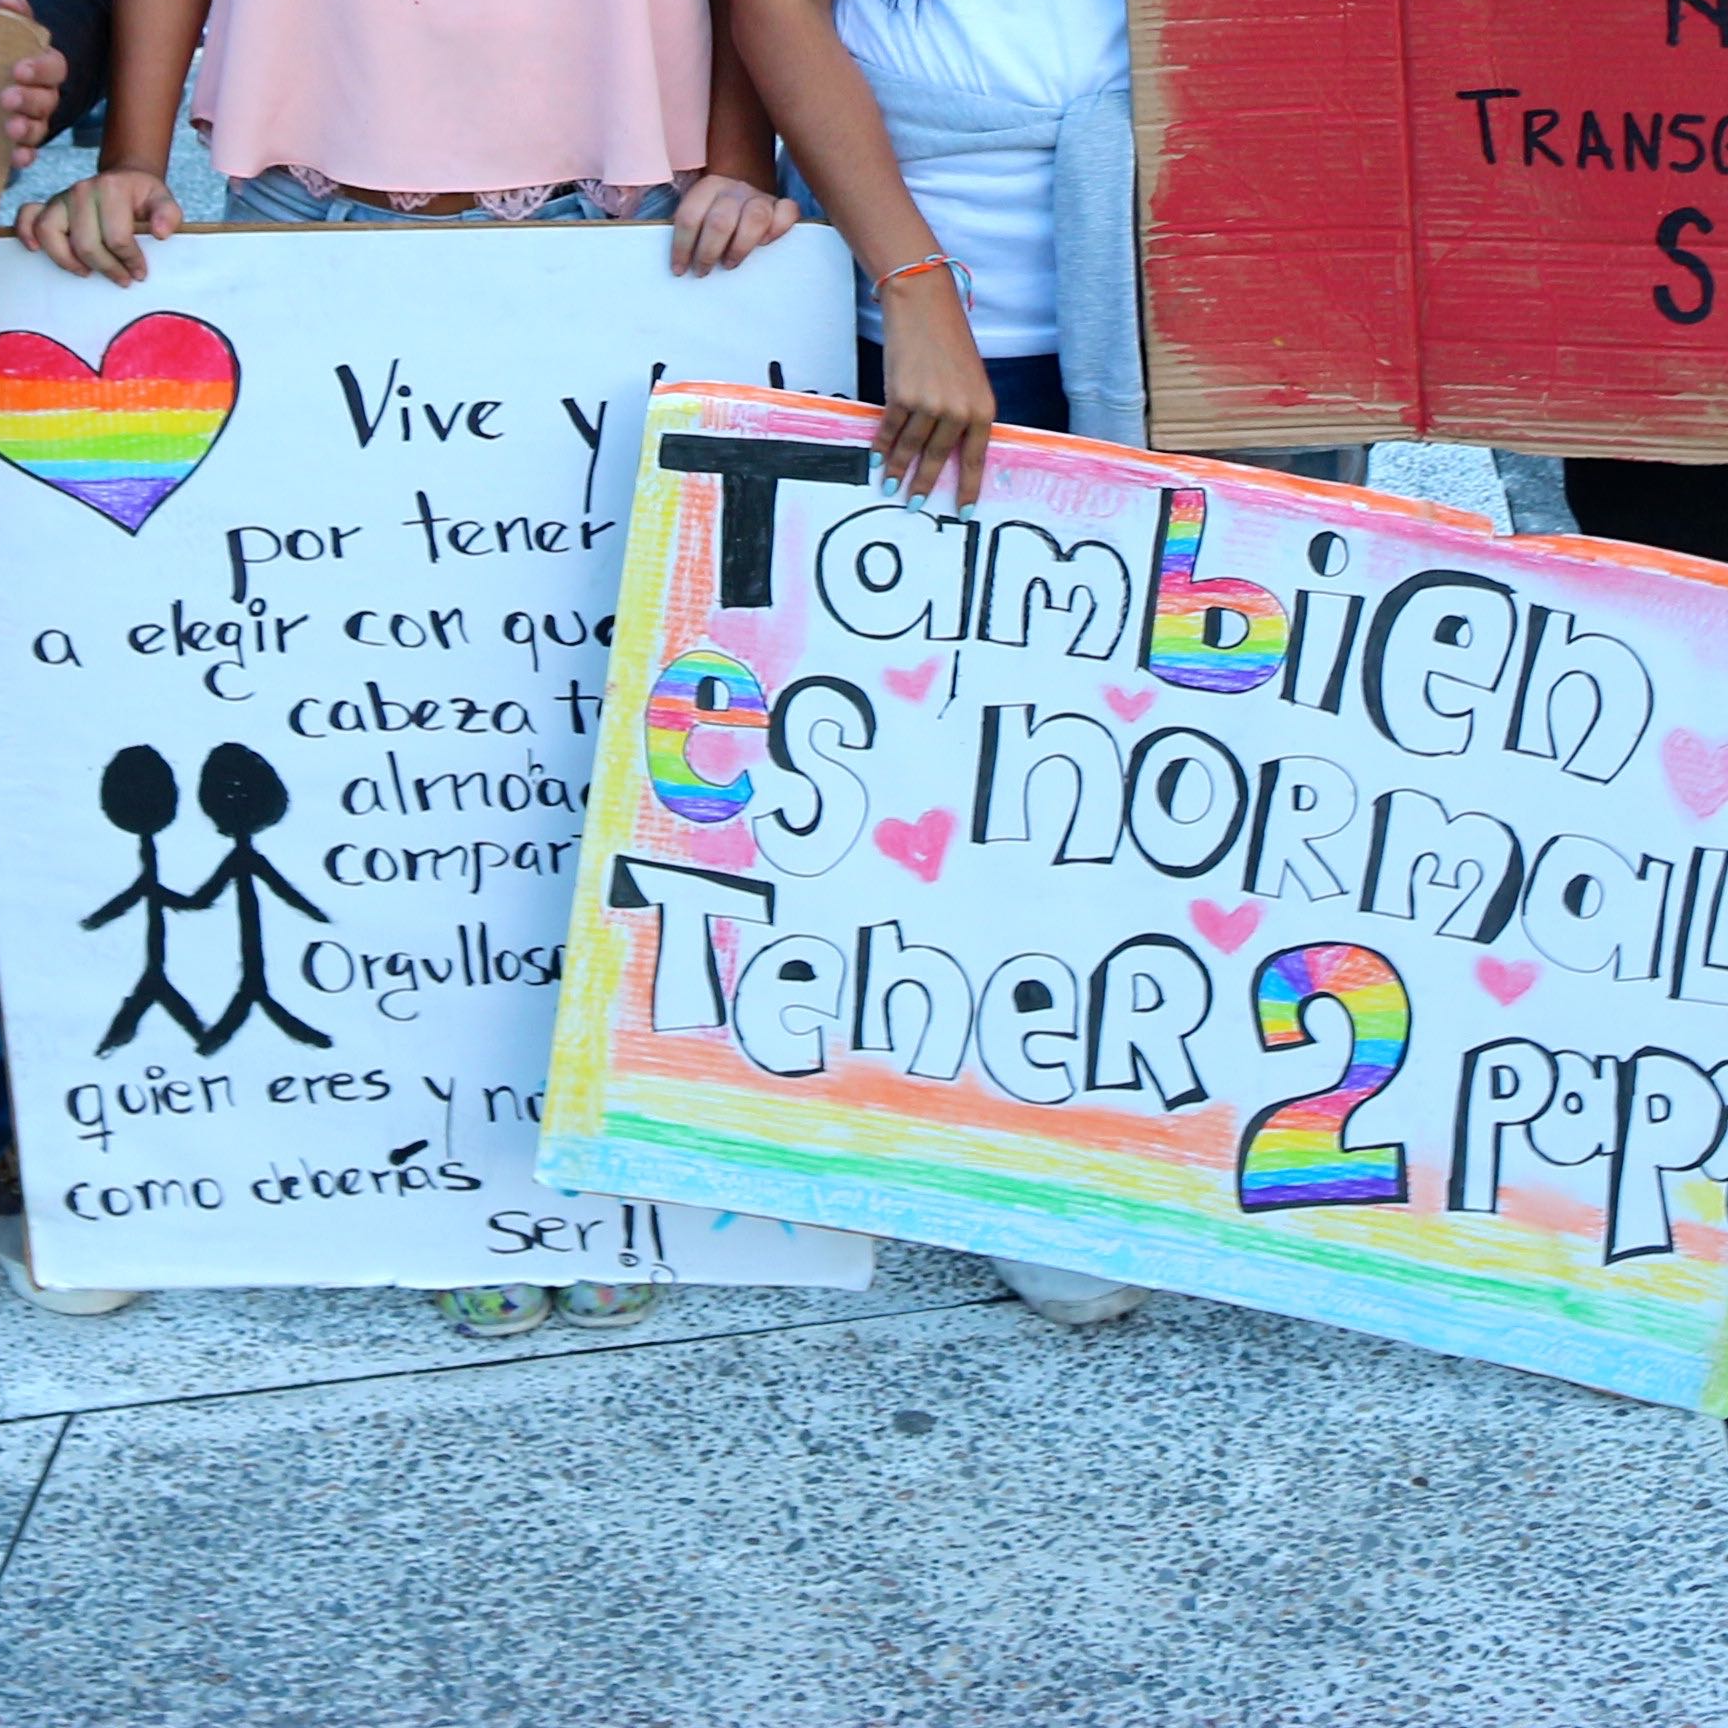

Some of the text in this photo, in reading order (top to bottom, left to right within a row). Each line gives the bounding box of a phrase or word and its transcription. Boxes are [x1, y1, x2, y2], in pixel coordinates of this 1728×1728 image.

[336, 358, 608, 512] Vive y
[226, 491, 616, 603] por tener
[33, 625, 81, 667] a
[127, 599, 308, 701] elegir
[345, 607, 471, 649] con
[289, 682, 537, 739] cabeza
[66, 1066, 234, 1152] quien
[270, 1068, 390, 1106] eres
[423, 1076, 454, 1159] y
[1239, 942, 1411, 1213] 2
[67, 1176, 223, 1221] como
